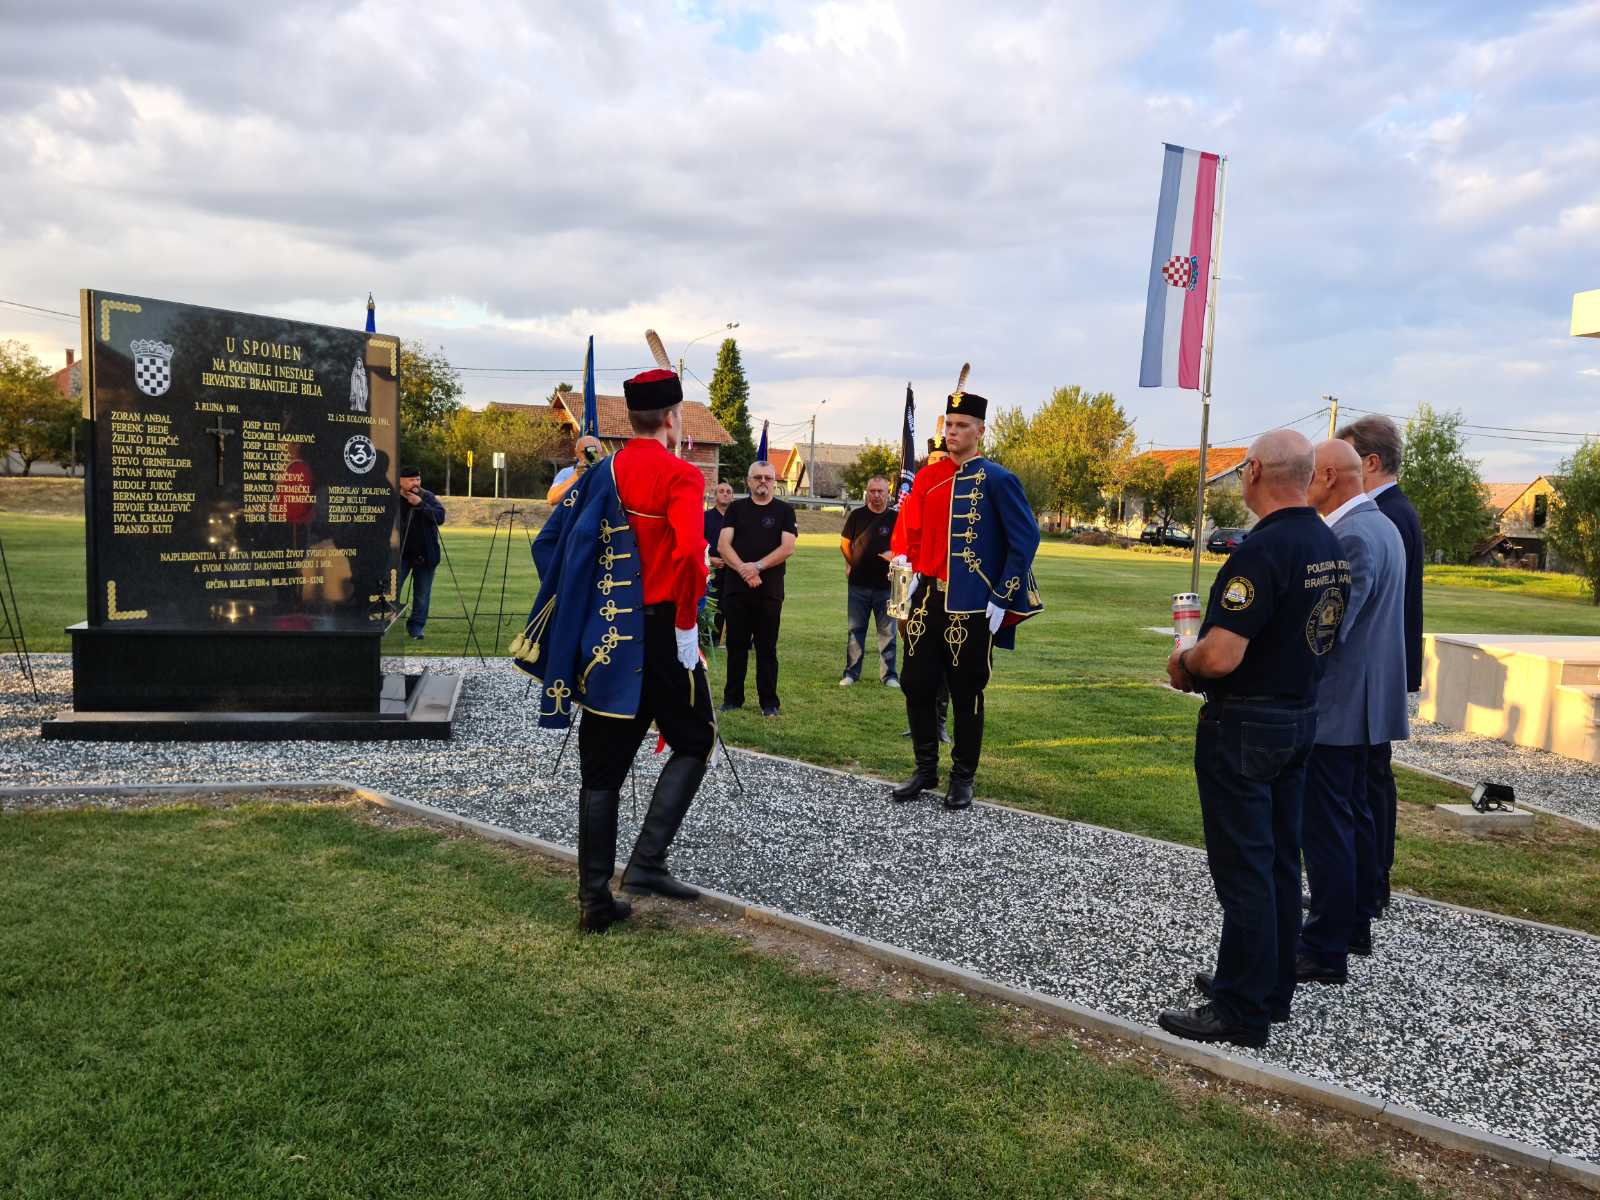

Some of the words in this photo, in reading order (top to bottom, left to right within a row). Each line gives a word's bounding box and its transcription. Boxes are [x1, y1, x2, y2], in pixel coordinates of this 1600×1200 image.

[226, 337, 235, 352] U
[243, 339, 301, 360] SPOMEN
[212, 358, 226, 371] NA
[229, 360, 271, 376] POGINULE
[280, 366, 314, 381] NESTALE
[202, 372, 246, 388] HRVATSKE
[250, 379, 297, 394] BRANITELJE
[301, 383, 322, 396] BILJA
[112, 411, 140, 421] ZORAN
[144, 414, 172, 423] ANĐAL
[112, 423, 144, 433] FERENC
[147, 426, 169, 434] BEDE
[243, 421, 261, 429] JOSIP
[264, 422, 280, 430] KUTI
[112, 432, 142, 443] ŽELJKO
[147, 435, 179, 445] FILIPČIĆ
[243, 430, 275, 440] ČEDOMIR
[278, 433, 315, 443] LAZAREVIĆ
[112, 445, 132, 454] IVAN
[136, 446, 166, 455] FORJAN
[243, 441, 261, 449] JOSIP
[243, 451, 268, 460] NIKICA
[112, 457, 139, 465] STEVO
[143, 458, 192, 467] GRINFELDER
[113, 466, 142, 476] IŠTVAN
[146, 469, 177, 478] HORVAT
[243, 472, 266, 480] DAMIR
[113, 481, 146, 489] RUDOLF
[150, 480, 173, 490] JUKIĆ
[244, 484, 273, 492] BRANKO
[329, 486, 359, 494] MIROSLAV
[113, 492, 152, 500] BERNARD
[156, 493, 195, 501] KOTARSKI
[244, 494, 280, 502] STANISLAV
[113, 503, 144, 511] HRVOJE
[149, 502, 191, 512] KRALJEVIĆ
[114, 514, 137, 522] IVICA
[140, 514, 173, 522] KRKALO
[244, 514, 265, 522] TIBOR
[114, 525, 149, 533] BRANKO
[152, 525, 172, 533] KUTI
[202, 564, 221, 572] SVOM
[224, 563, 251, 571] NARODU
[254, 562, 284, 570] DAROVATI
